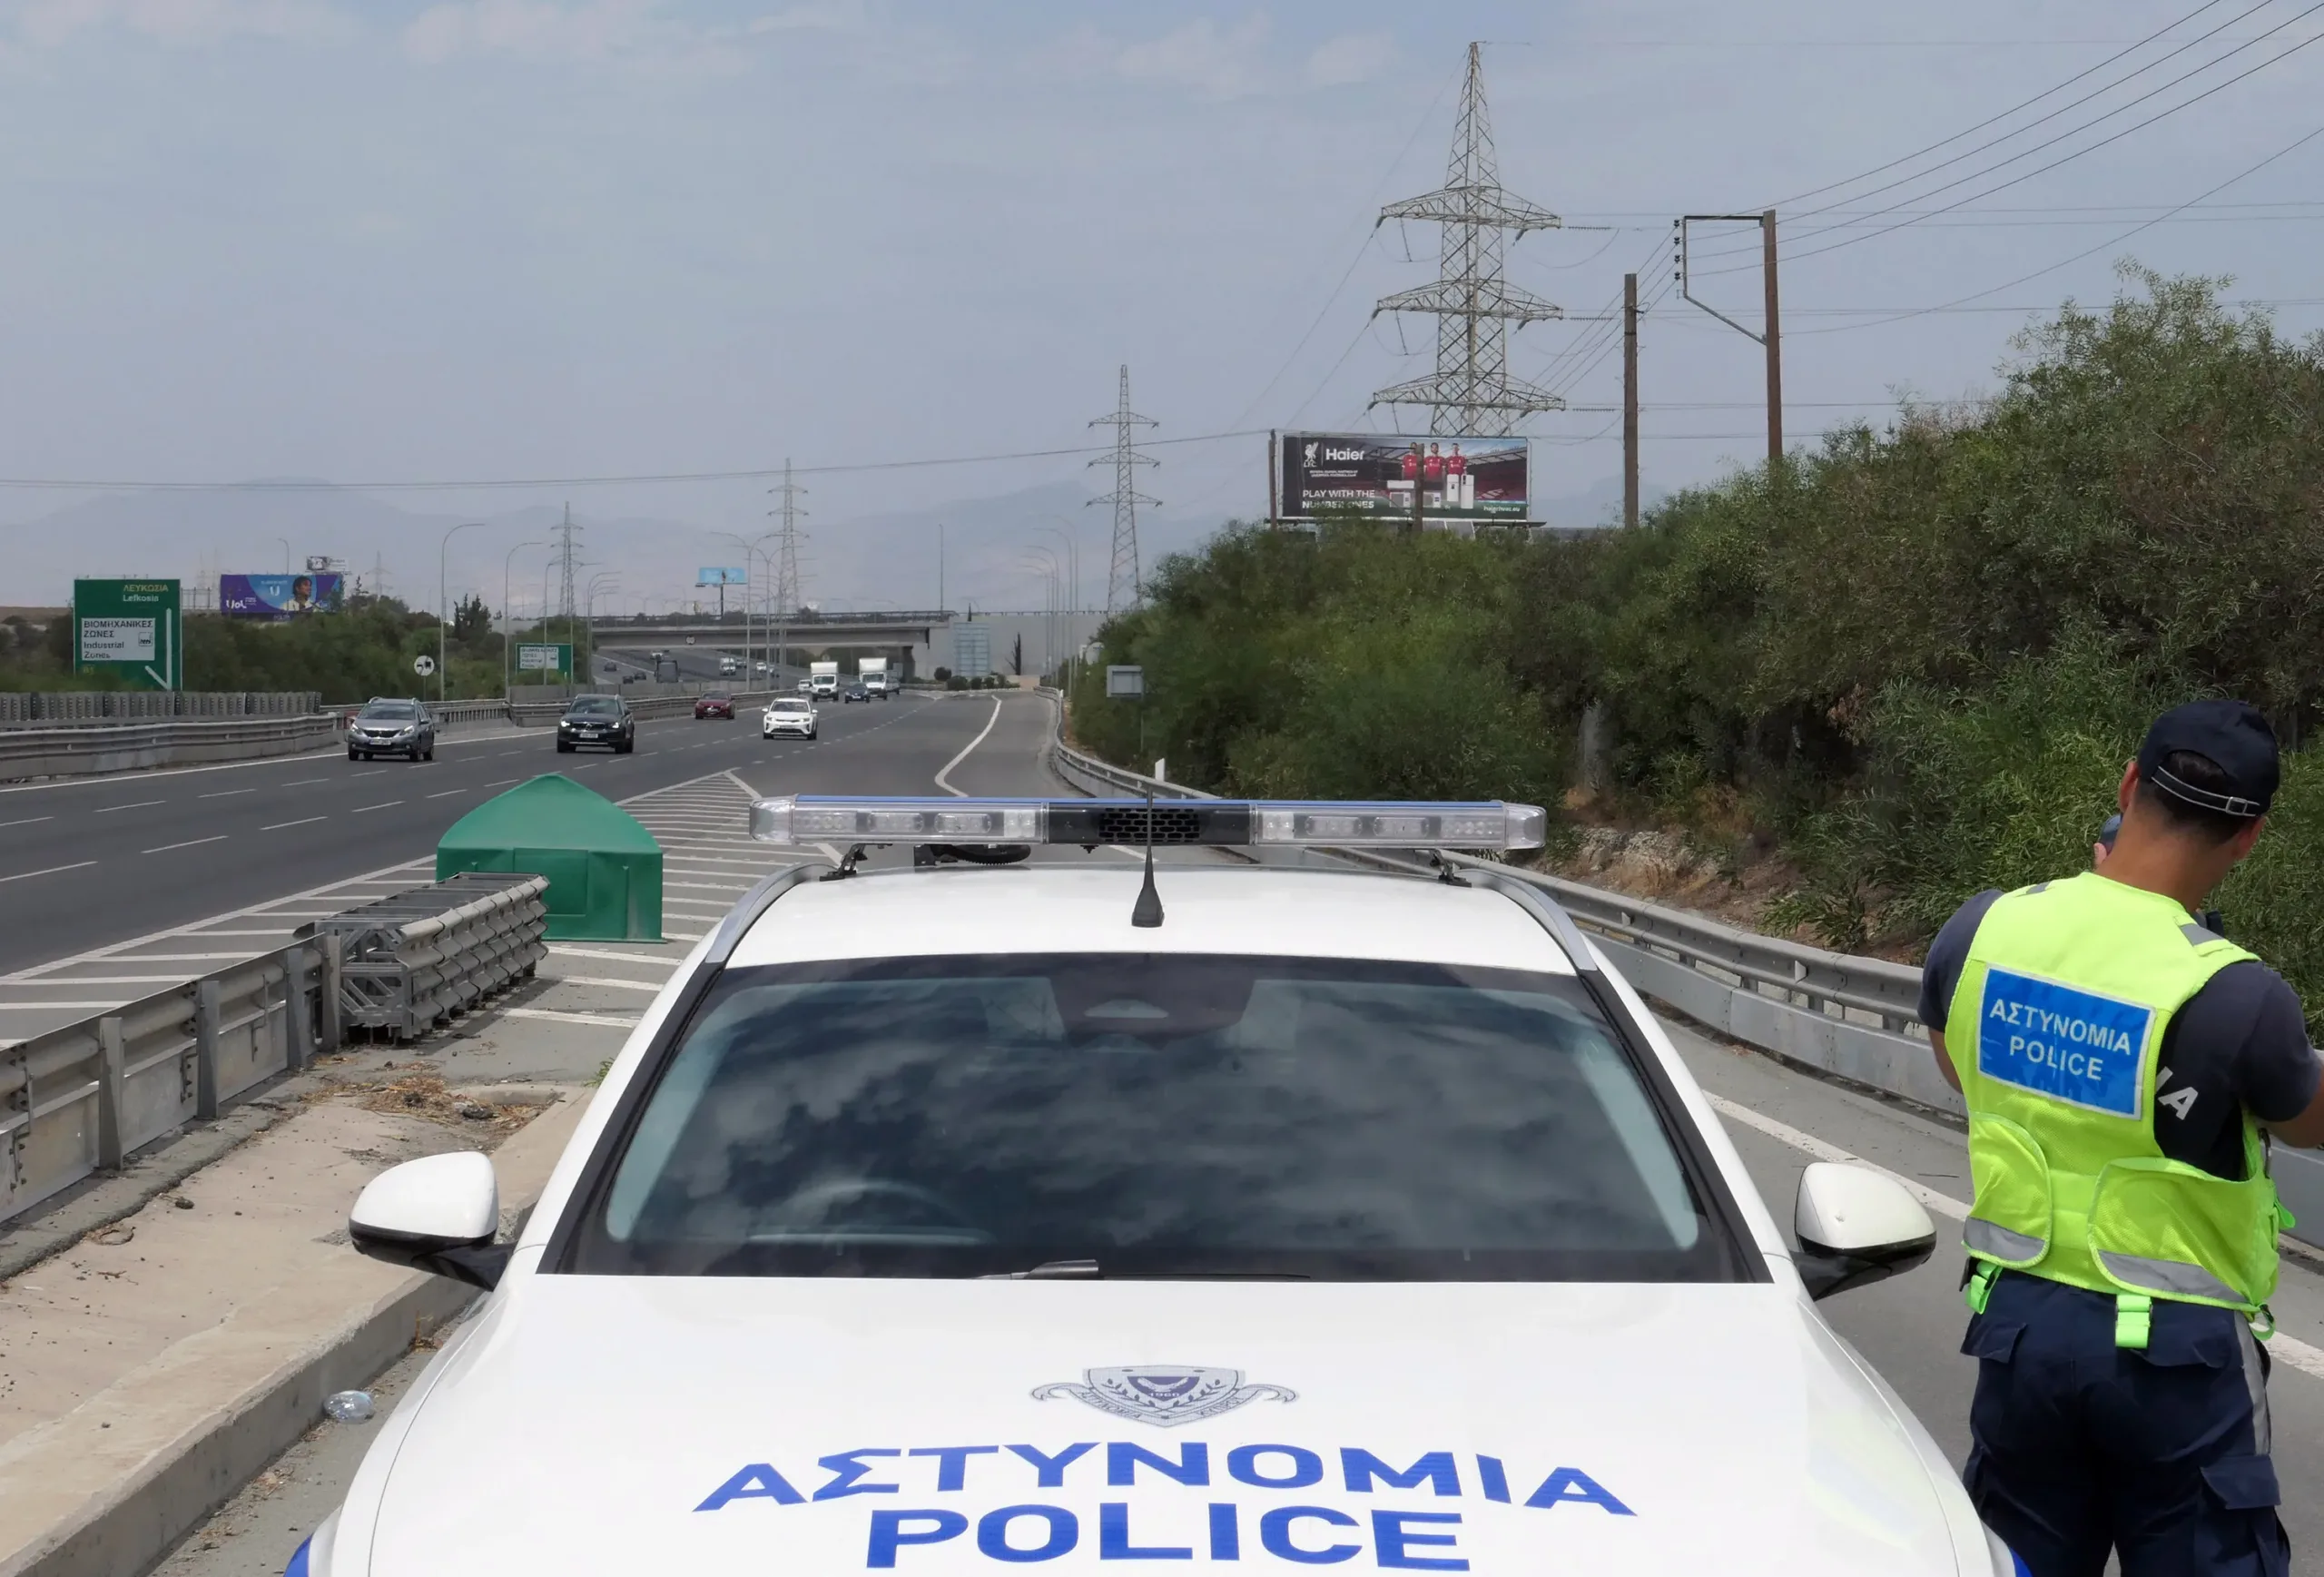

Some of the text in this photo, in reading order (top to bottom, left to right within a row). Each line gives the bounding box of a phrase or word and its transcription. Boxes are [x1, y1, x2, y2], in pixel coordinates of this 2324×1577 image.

[1325, 448, 1364, 460] Haier
[1303, 489, 1375, 498] PLAY WITH THE
[123, 584, 169, 592] ΛΕΥΚΩΣΙΑ
[84, 620, 153, 628] ΒΙΟΜΗΧΑΝΙΚΕΣ
[84, 630, 114, 638] ΖΩΝΕΣ
[84, 641, 124, 649] Industrial
[84, 651, 111, 659] Zones
[1989, 999, 2131, 1055] ΑΣΤΥΝΟΜΙΑ
[2009, 1035, 2103, 1081] POLICE
[692, 1441, 1639, 1517] ΑΣΤΥΝΟΜΙΑ
[866, 1502, 1471, 1572] POLICE
